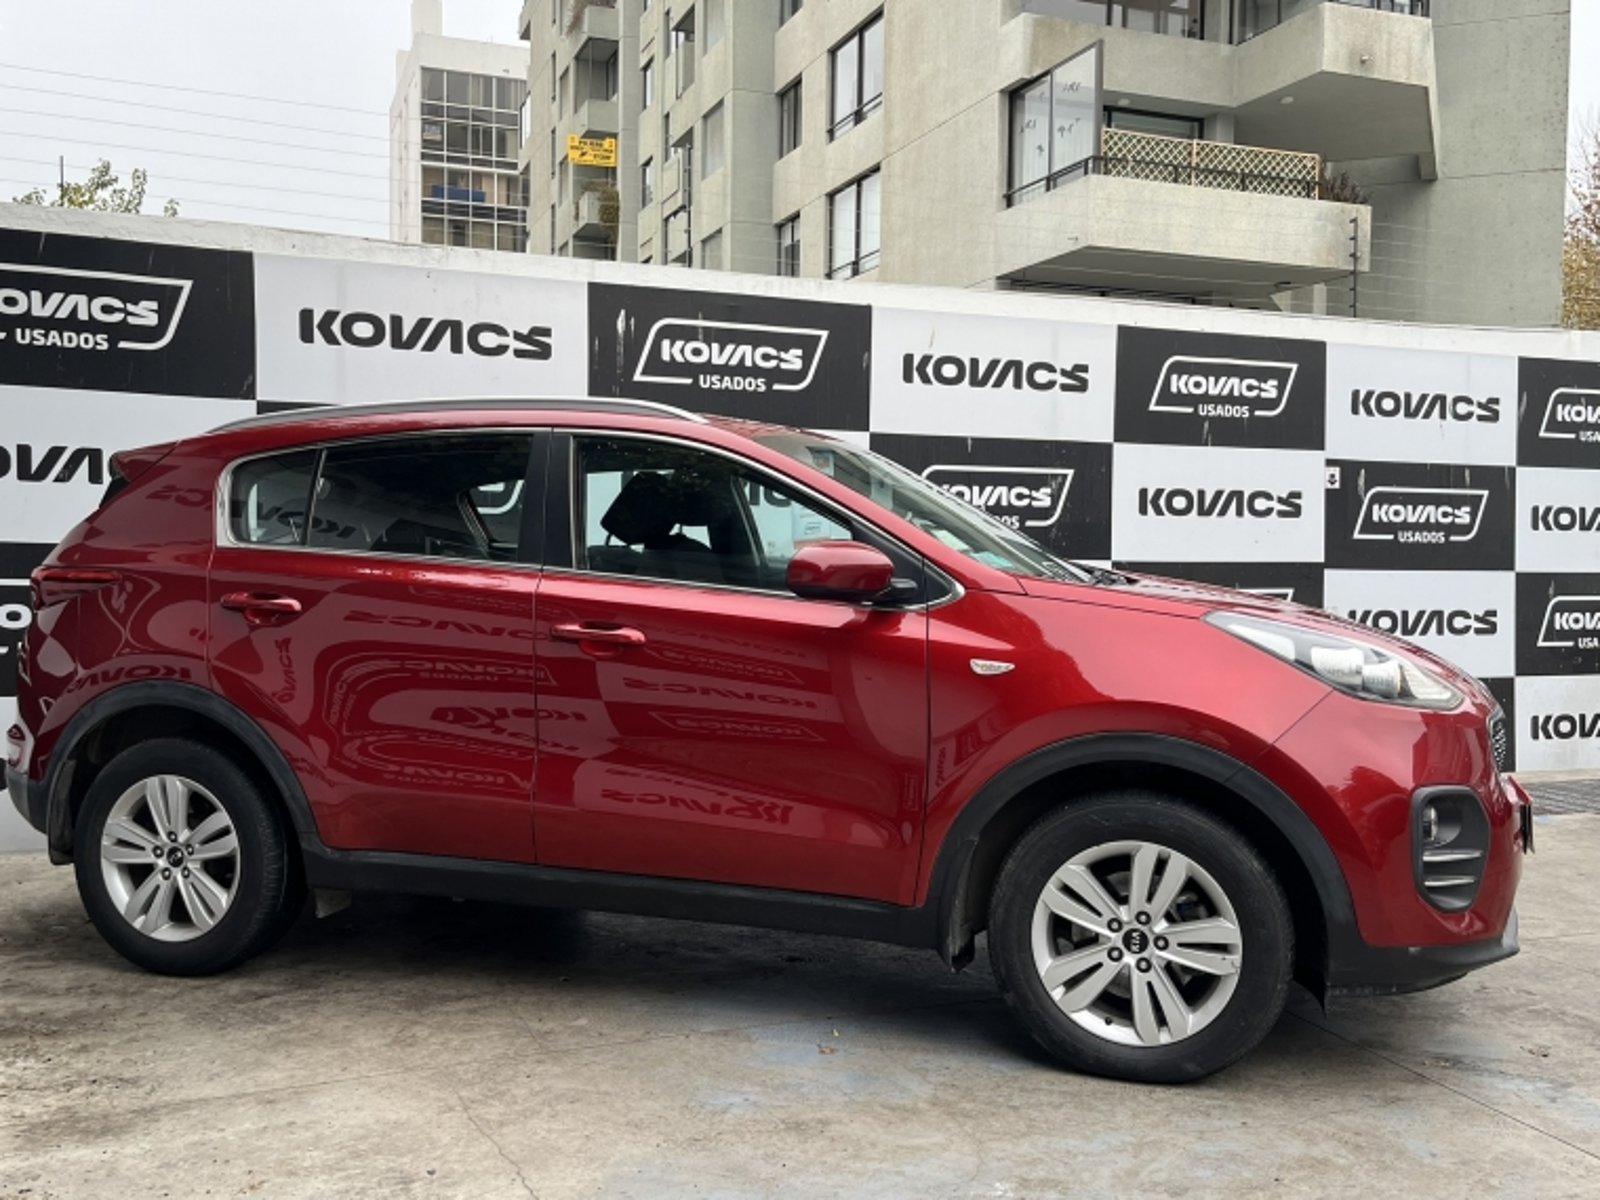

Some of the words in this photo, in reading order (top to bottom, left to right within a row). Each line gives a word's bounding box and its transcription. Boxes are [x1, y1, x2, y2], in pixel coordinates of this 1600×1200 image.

[15, 327, 109, 351] USADOS
[299, 308, 552, 360] KOVACS
[661, 338, 803, 371] KOVACS
[698, 374, 767, 393] USADOS
[902, 353, 1089, 394] KOVACS
[1170, 373, 1279, 399] KOVACS
[1198, 403, 1250, 418] USADOS
[1350, 389, 1500, 423] KOVACS
[1556, 403, 1600, 424] KOV
[940, 484, 1052, 508] OVACS
[1138, 487, 1303, 519] KOVACS
[1372, 503, 1471, 525] KOVACS
[1531, 505, 1600, 532] KOV
[1397, 530, 1446, 544] USADOS
[1554, 612, 1600, 630] KOV
[1530, 712, 1600, 741] KOV
